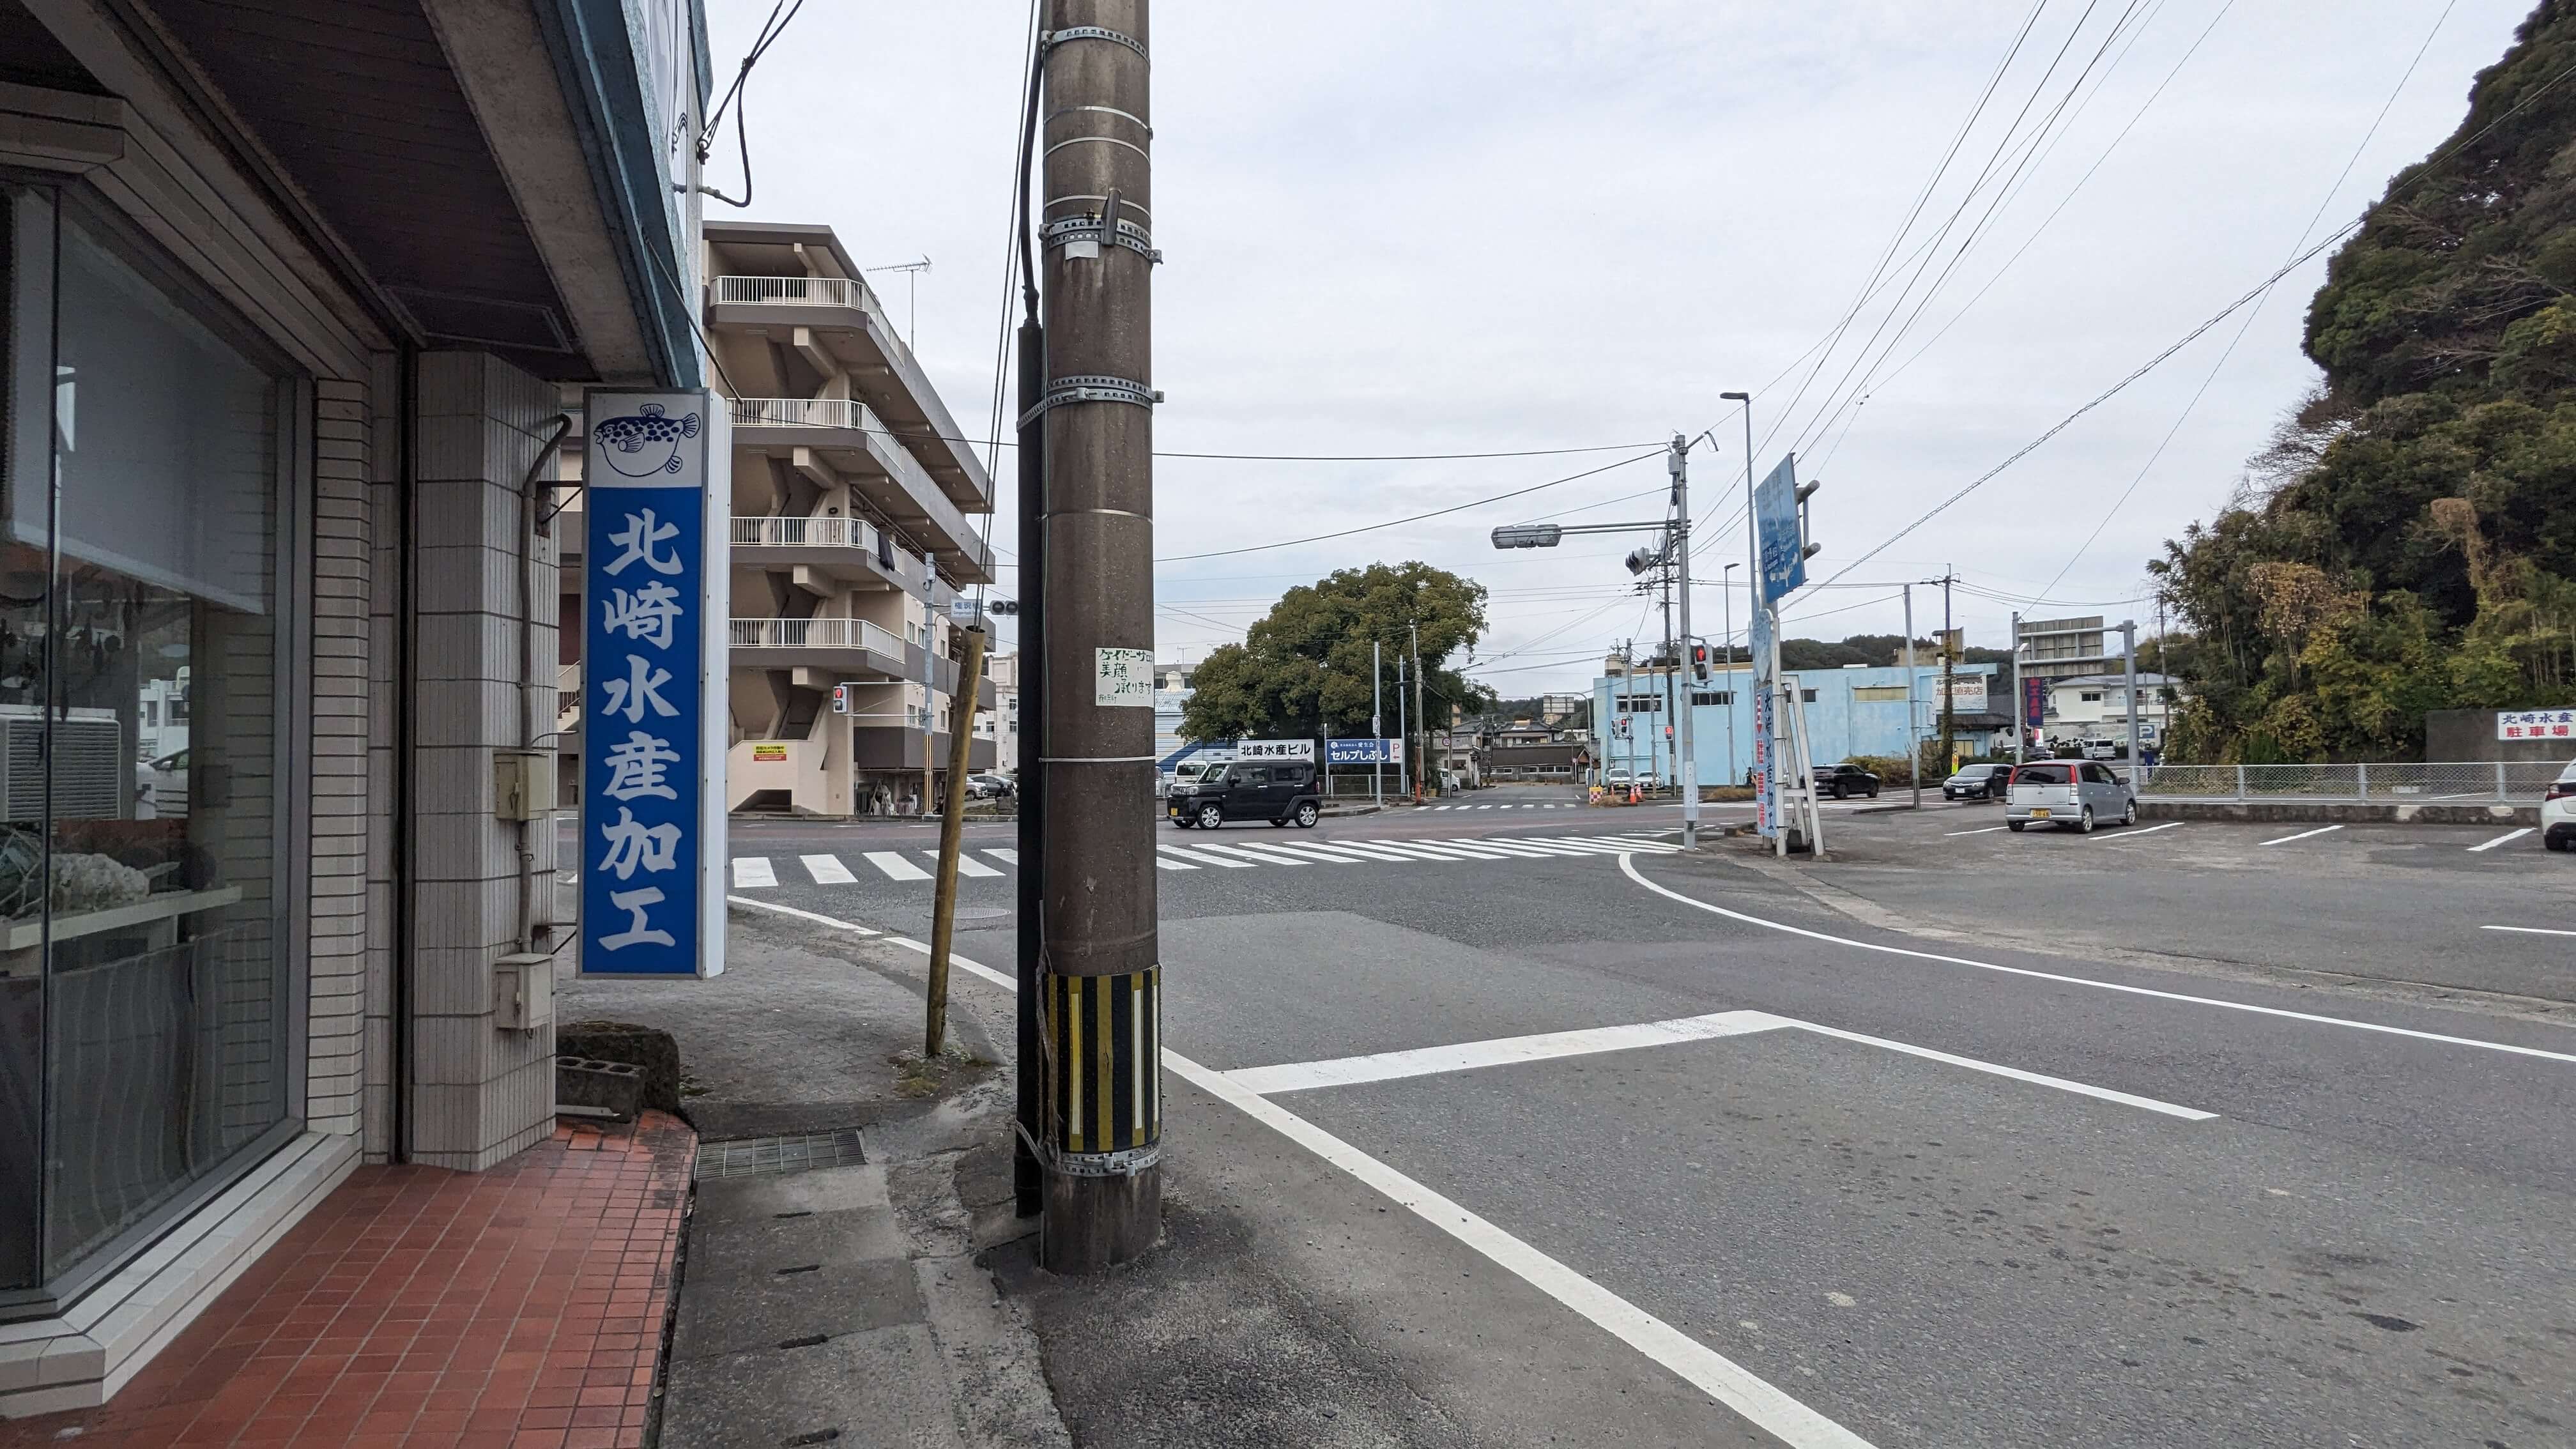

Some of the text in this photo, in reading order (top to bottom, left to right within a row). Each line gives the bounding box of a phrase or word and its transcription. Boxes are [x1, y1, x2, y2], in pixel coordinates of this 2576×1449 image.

[1100, 662, 1128, 678] 美顔
[1114, 678, 1151, 694] 承ります
[2503, 712, 2573, 724] 北崎水産
[598, 507, 684, 951] 北崎水産加工
[2140, 726, 2153, 737] P
[2506, 725, 2569, 737] 駐車場
[1241, 744, 1311, 756] 北崎水産ビル
[1393, 743, 1400, 753] P
[1331, 750, 1388, 760] セルプしぶし
